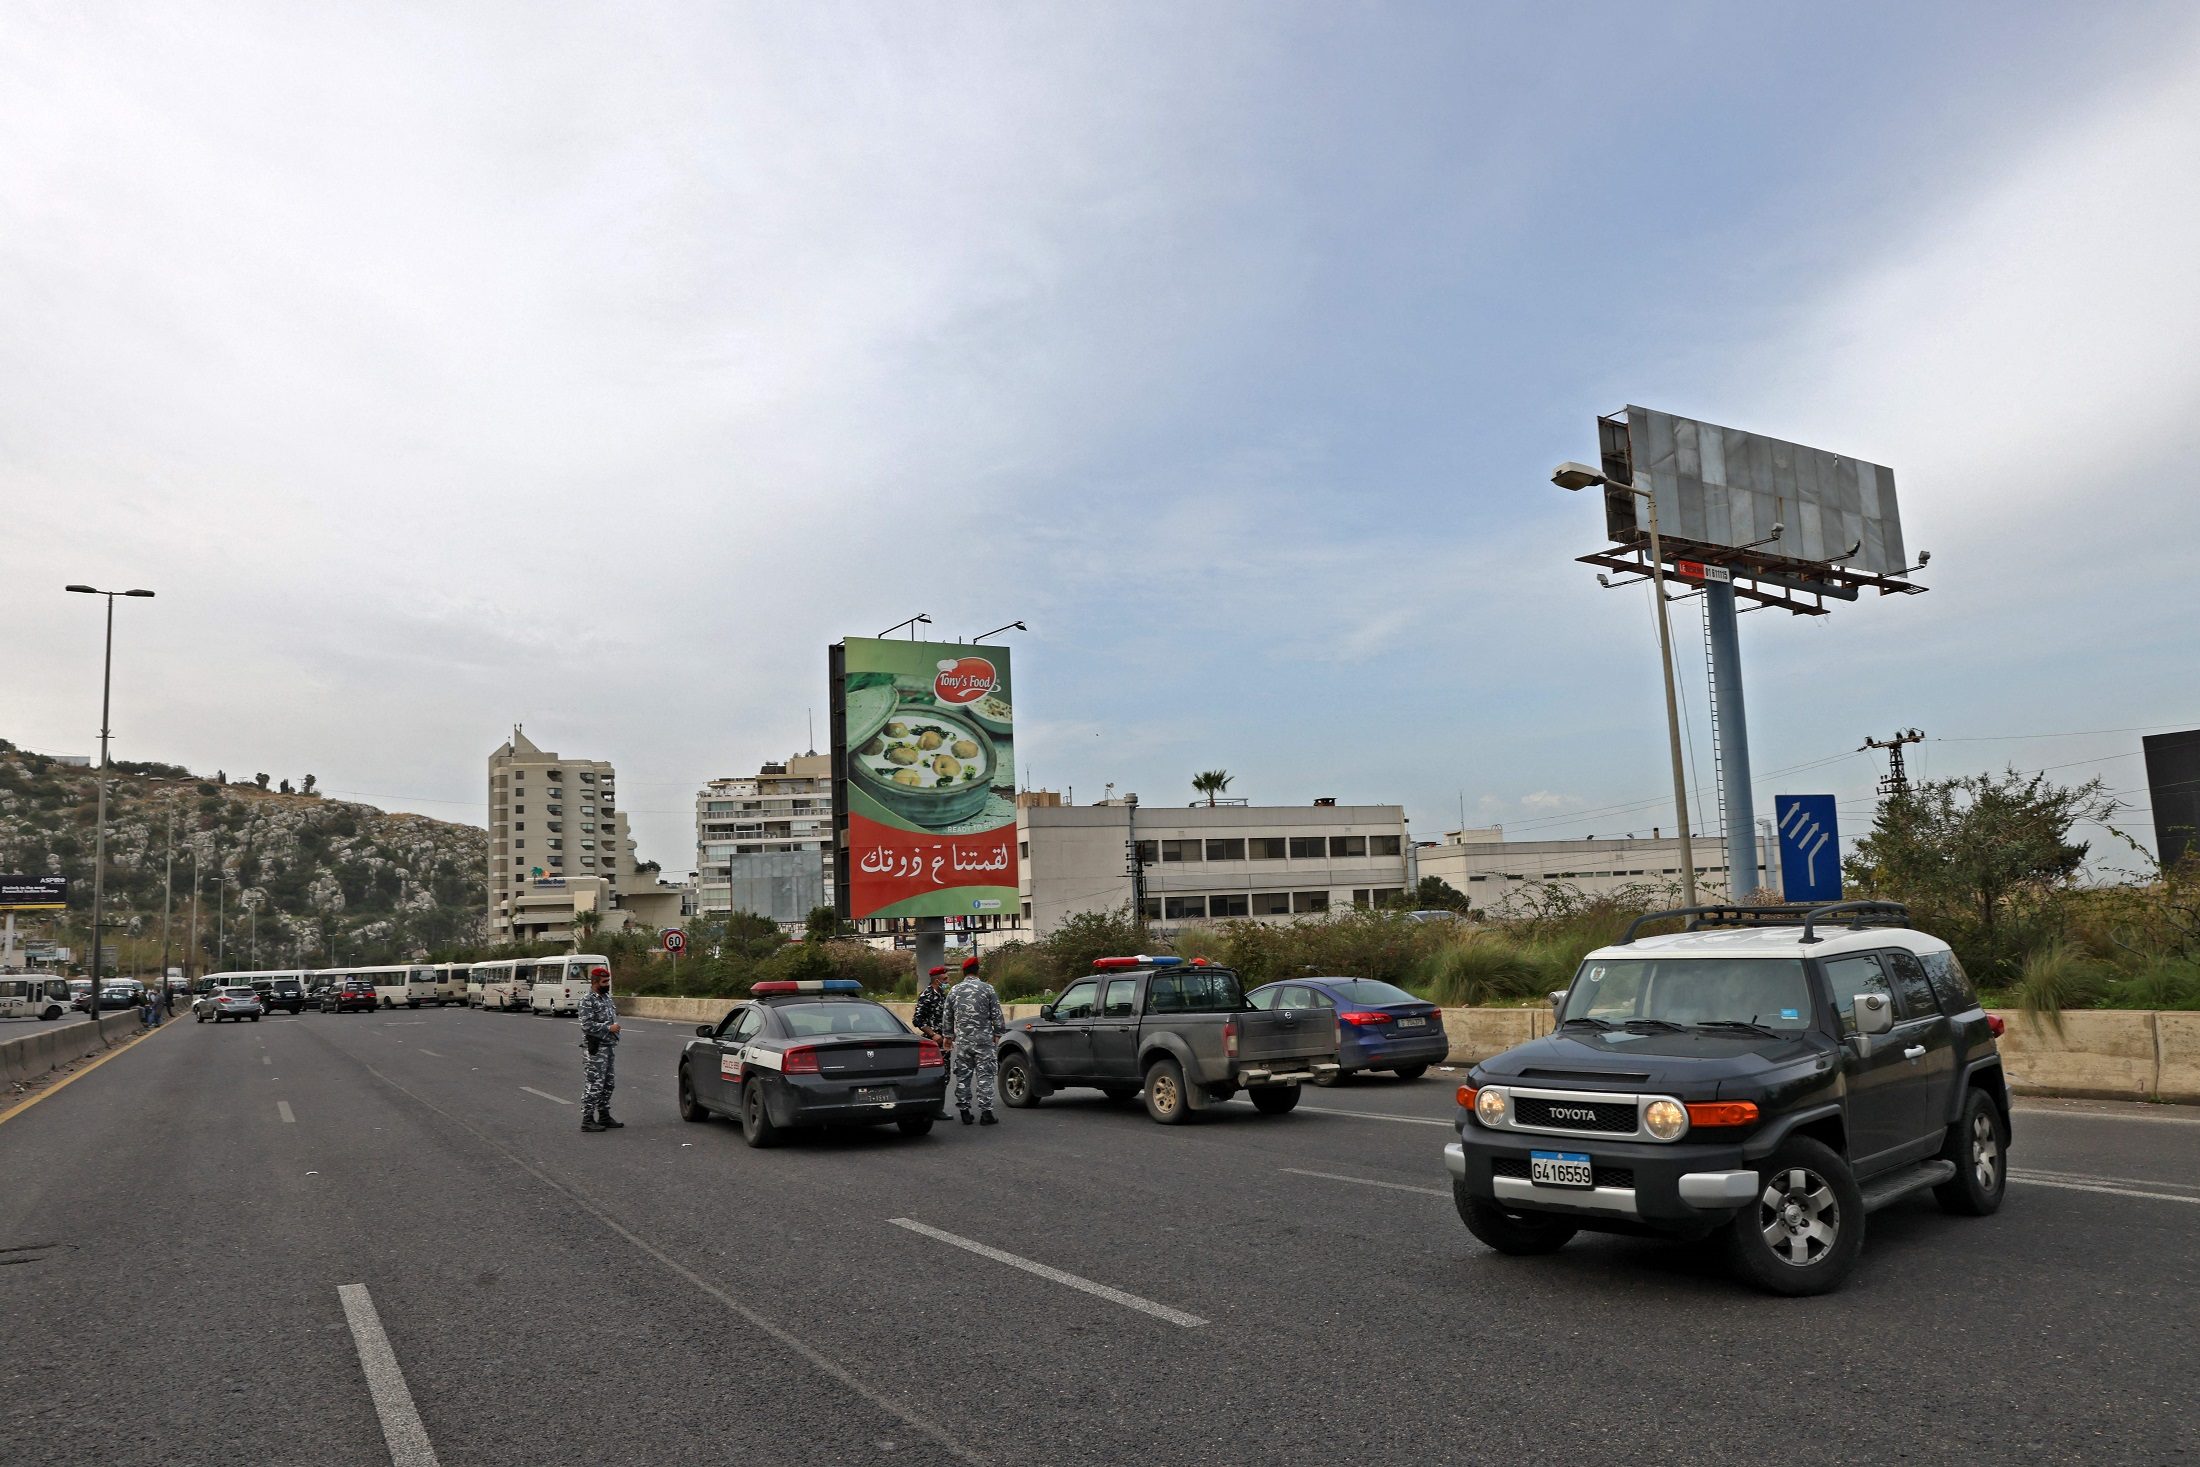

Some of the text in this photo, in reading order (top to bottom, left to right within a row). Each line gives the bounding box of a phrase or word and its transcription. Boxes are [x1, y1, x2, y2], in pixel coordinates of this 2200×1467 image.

[940, 673, 991, 689] Tony's Food
[947, 825, 971, 833] READY
[952, 842, 1008, 872] لقمتنا
[668, 936, 681, 946] 60
[1549, 1107, 1596, 1121] TOYOTA
[1533, 1163, 1591, 1184] G416559
